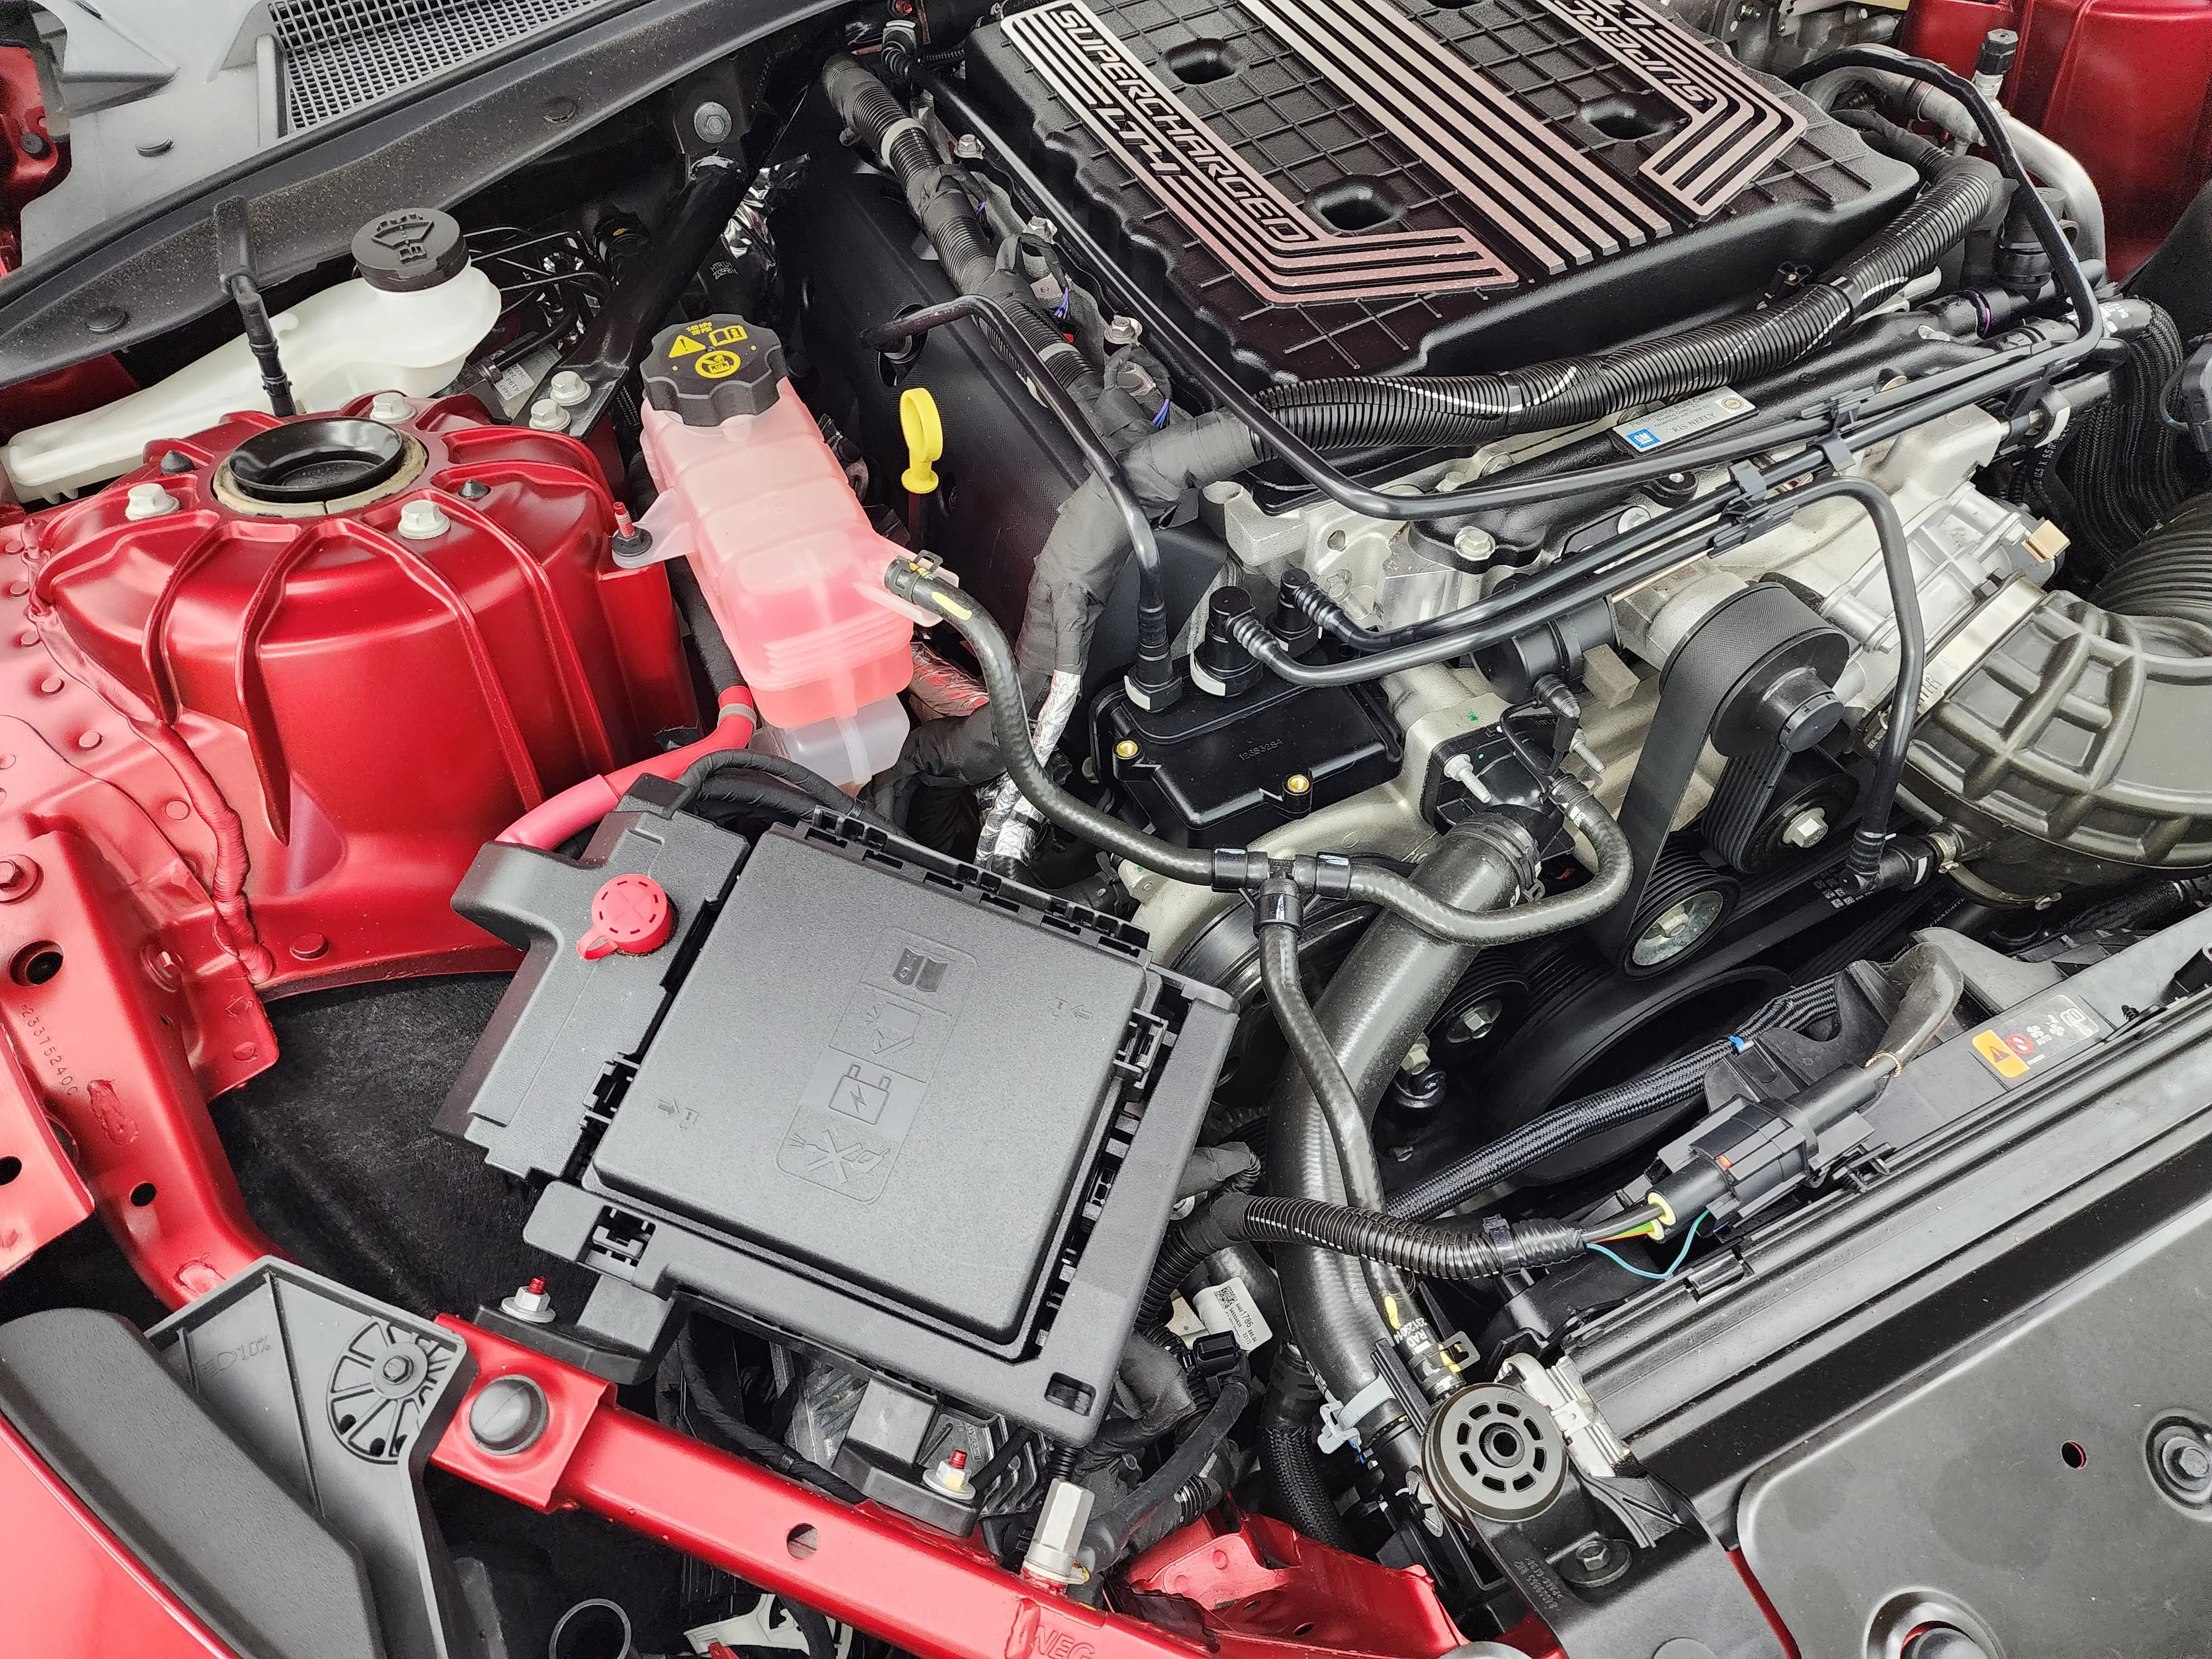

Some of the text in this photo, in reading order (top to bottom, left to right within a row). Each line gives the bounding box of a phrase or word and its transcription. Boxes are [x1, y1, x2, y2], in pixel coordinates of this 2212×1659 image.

[1050, 10, 1310, 241] SUPERCHARGED
[1096, 108, 1181, 173] LT4
[506, 378, 520, 392] 4194
[1629, 393, 1717, 427] Performance Build Center
[1688, 413, 1717, 426] NEELY
[1634, 431, 1651, 442] GM
[1573, 812, 1587, 828] ENG
[2035, 1034, 2053, 1047] AUTO
[1406, 1328, 1428, 1349] RAD
[1035, 1625, 1095, 1659] NEG
